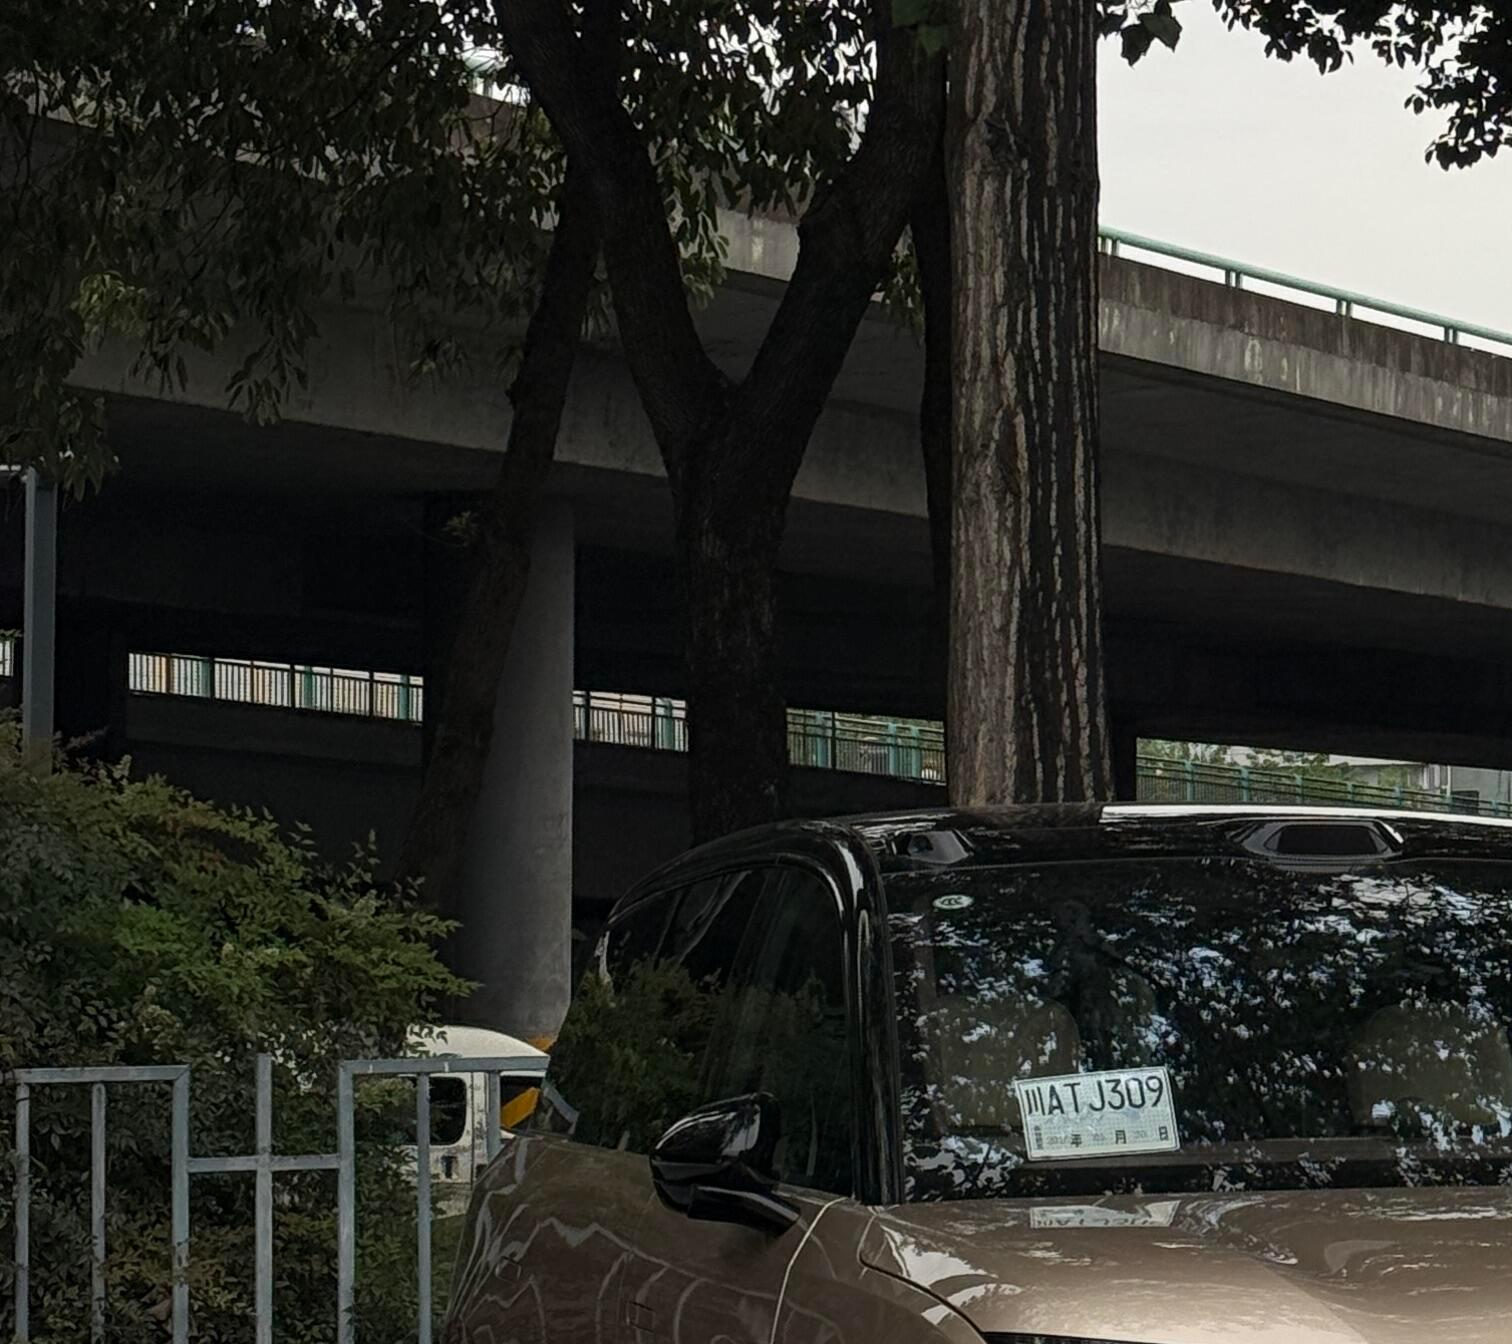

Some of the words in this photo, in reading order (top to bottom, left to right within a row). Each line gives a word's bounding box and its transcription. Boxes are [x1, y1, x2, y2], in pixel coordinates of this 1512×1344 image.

[1025, 1075, 1163, 1116] 川ATJ309
[1115, 1129, 1127, 1145] 月
[1158, 1125, 1169, 1141] 日
